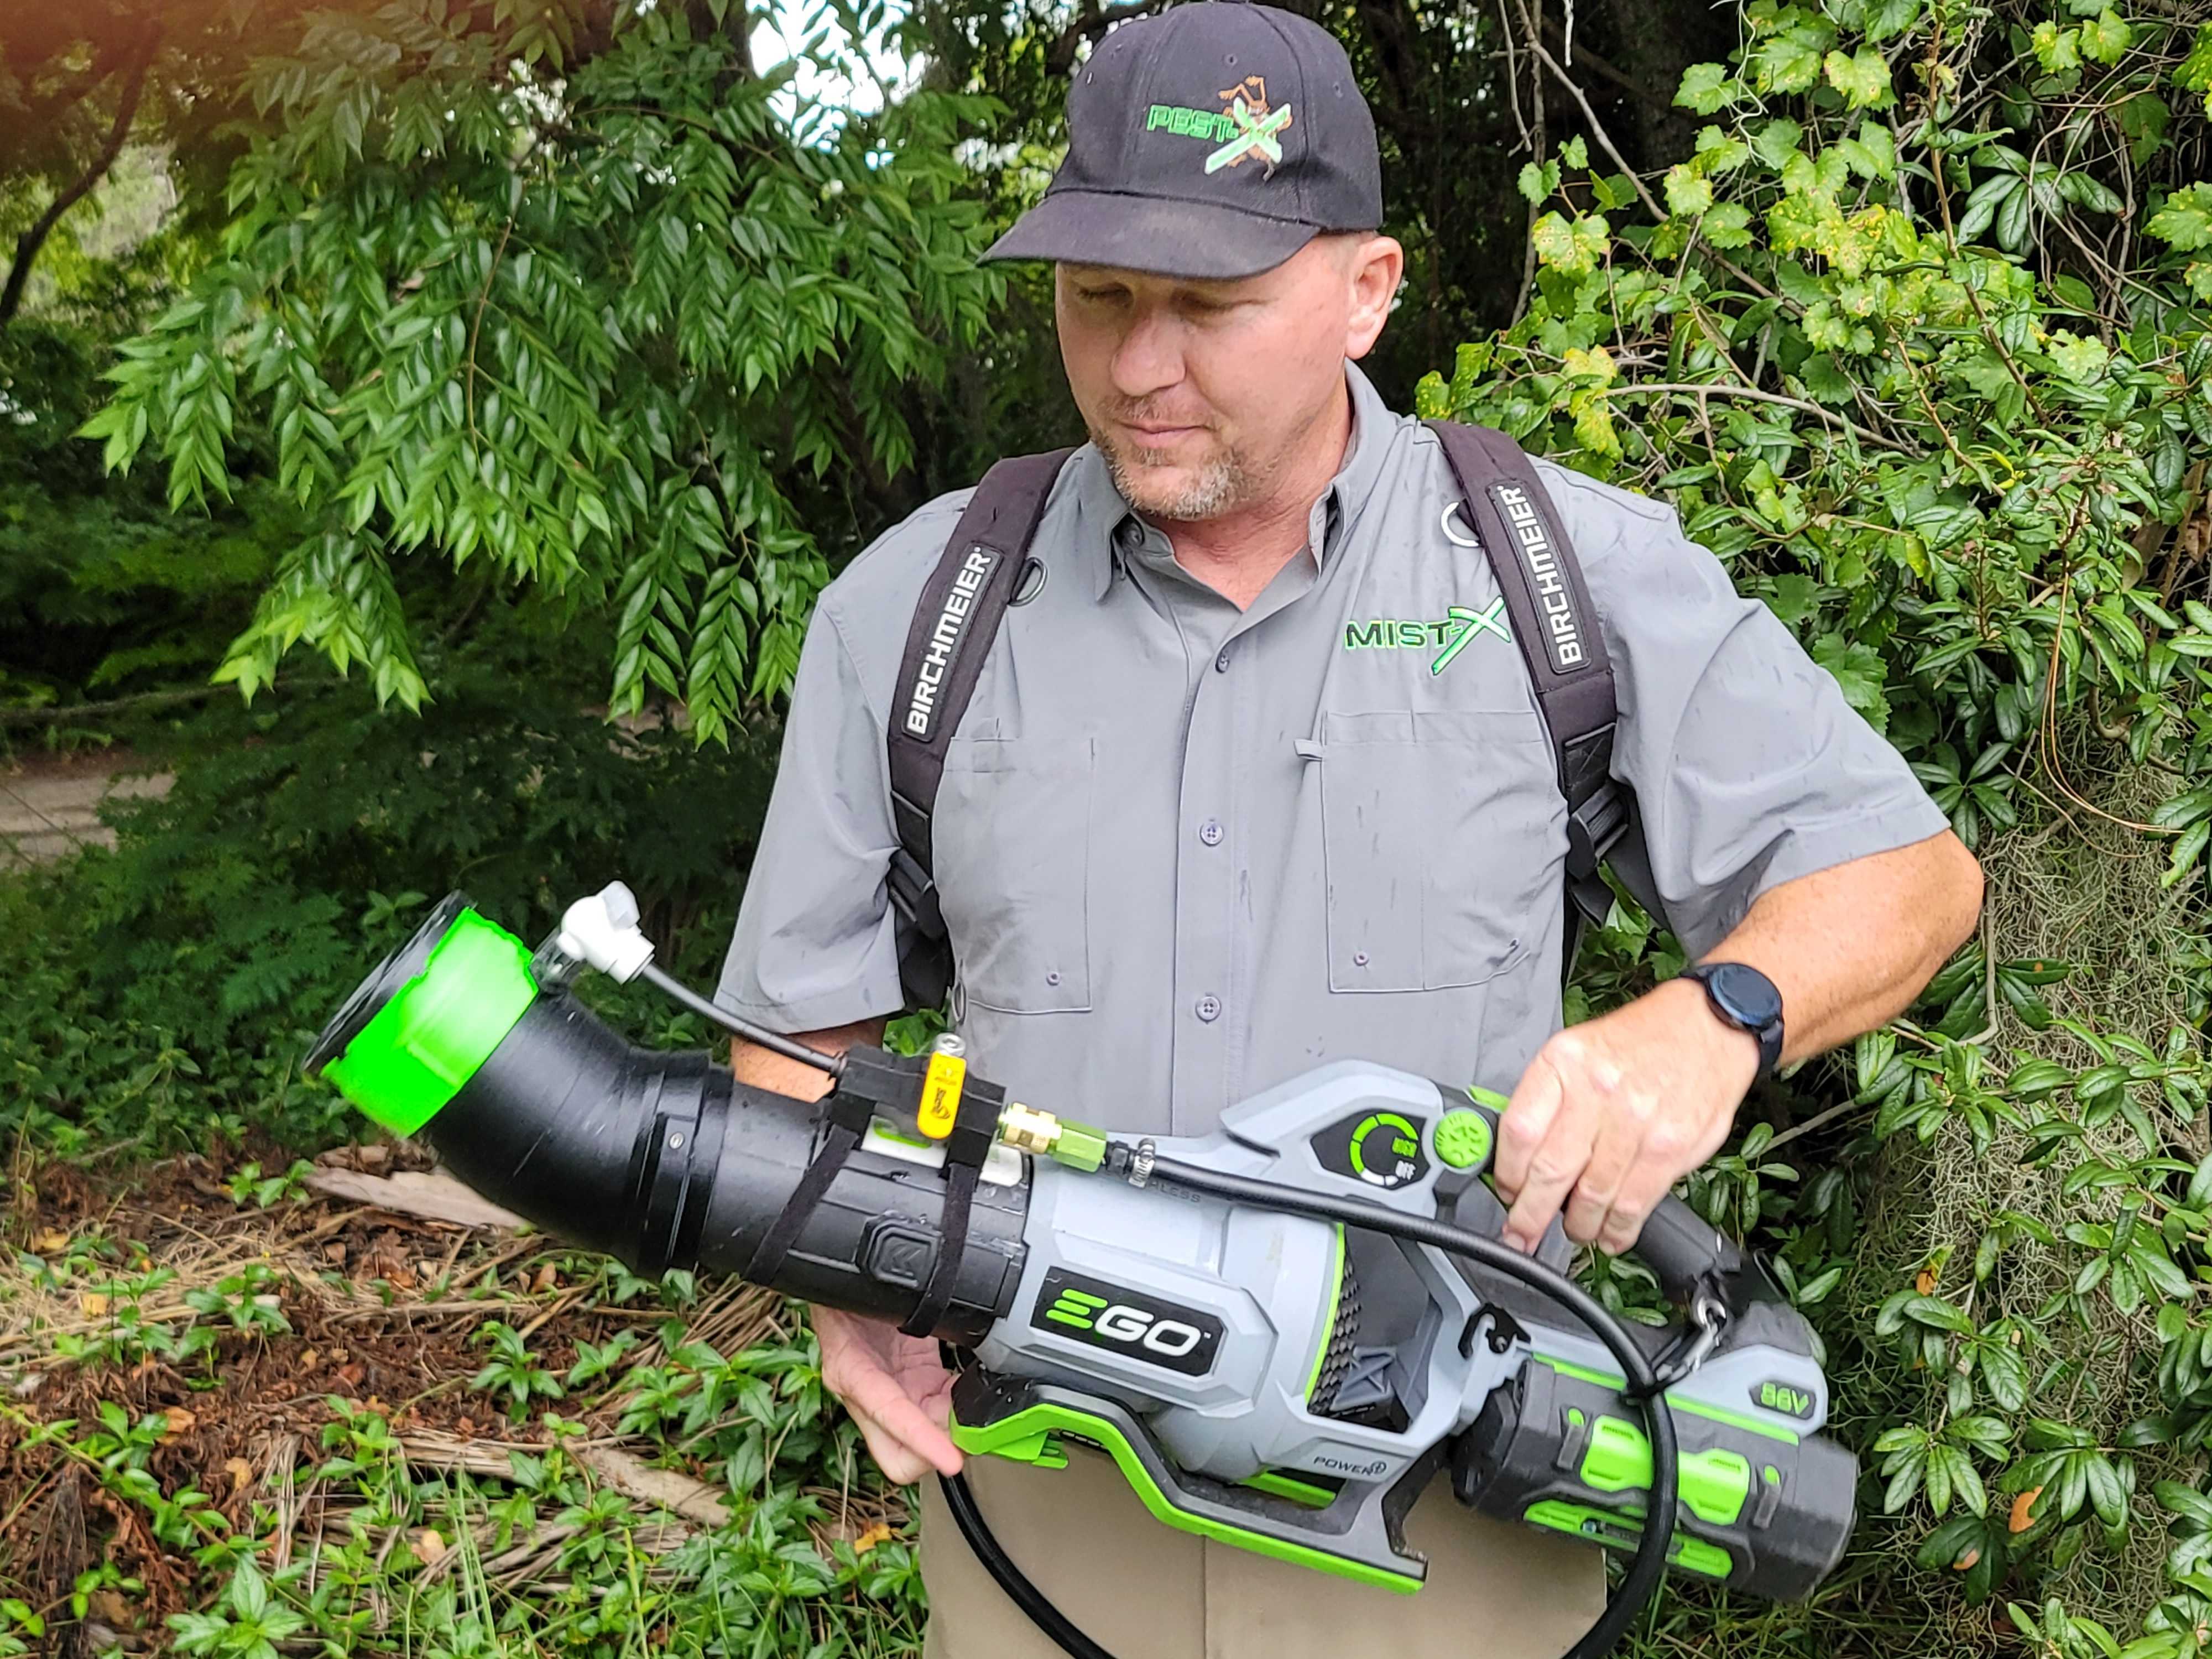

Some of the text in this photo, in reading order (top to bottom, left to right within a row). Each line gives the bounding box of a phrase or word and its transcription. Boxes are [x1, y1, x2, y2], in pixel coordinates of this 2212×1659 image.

[906, 552, 992, 734] BIRCHMEIER
[1500, 487, 1583, 665] BIRCHMEIER
[1046, 1288, 1202, 1357] EGO
